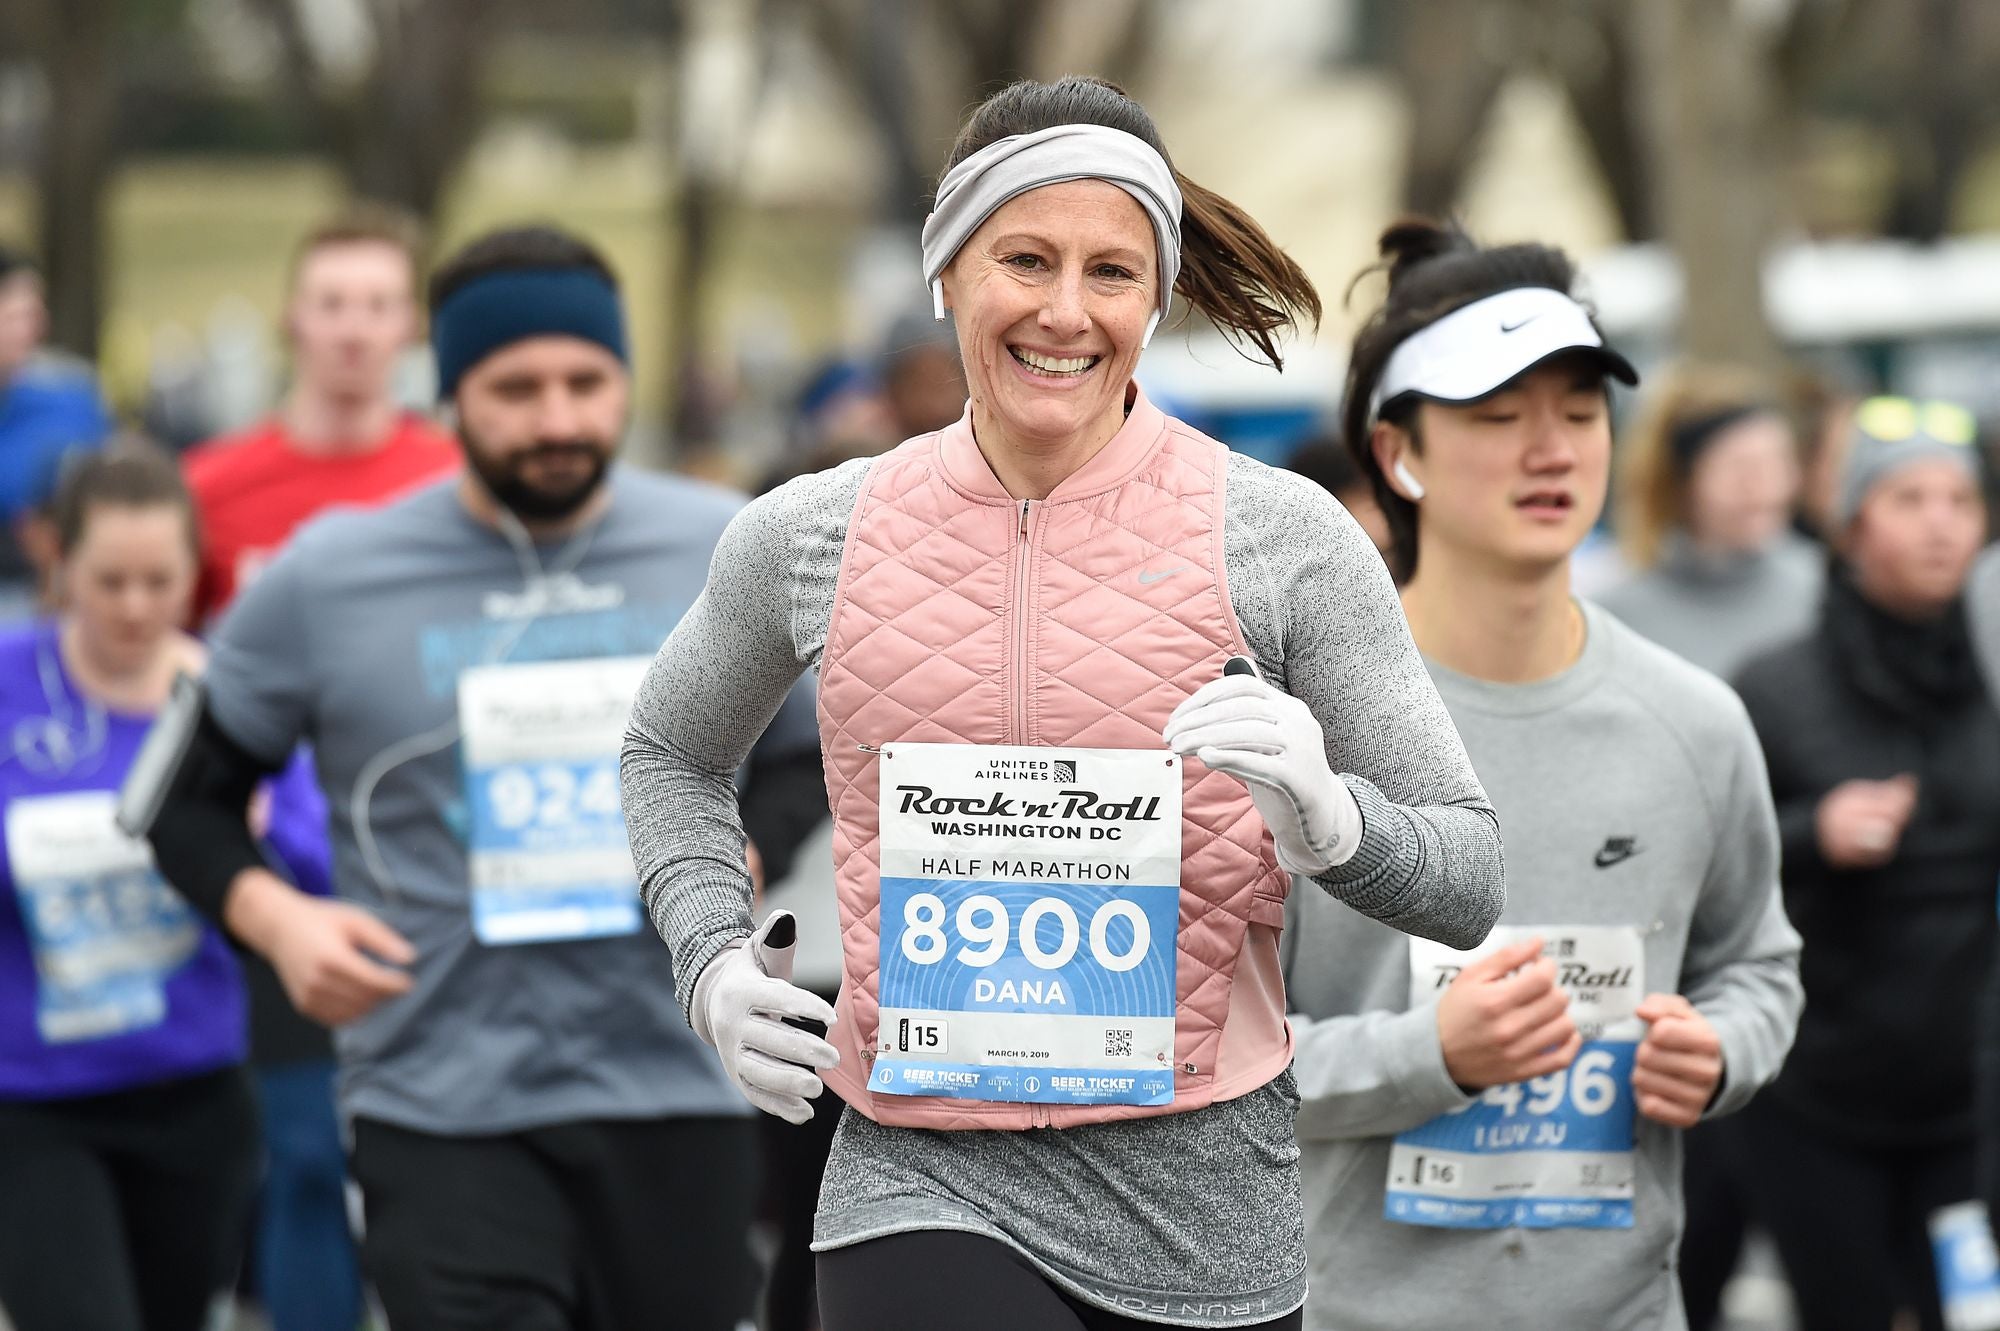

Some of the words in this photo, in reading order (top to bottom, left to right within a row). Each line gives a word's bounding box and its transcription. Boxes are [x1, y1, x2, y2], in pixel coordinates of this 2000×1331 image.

[974, 770, 1049, 781] AIRLINES
[990, 760, 1049, 770] UNITED
[895, 784, 1018, 817] Rock
[1058, 790, 1161, 821] Roll
[931, 821, 1081, 840] WASHINGTON
[1089, 827, 1122, 841] DC
[922, 857, 982, 876] HALF
[992, 860, 1130, 880] MARATHON
[901, 893, 1151, 972] 8900
[974, 978, 1066, 1005] DANA
[900, 1022, 908, 1050] CORRAL
[915, 1026, 939, 1047] 15
[987, 1049, 1019, 1058] MARCH
[1020, 1050, 1028, 1059] 9,
[1030, 1051, 1050, 1059] 2019
[902, 1068, 936, 1081] BEER
[937, 1071, 981, 1085] TICKET
[1051, 1076, 1085, 1088] BEER
[1087, 1078, 1135, 1090] TICKET
[1446, 1050, 1616, 1116] 496
[1430, 1163, 1456, 1184] 16
[1094, 1289, 1169, 1314] FOR
[1181, 1302, 1250, 1317] RUN
